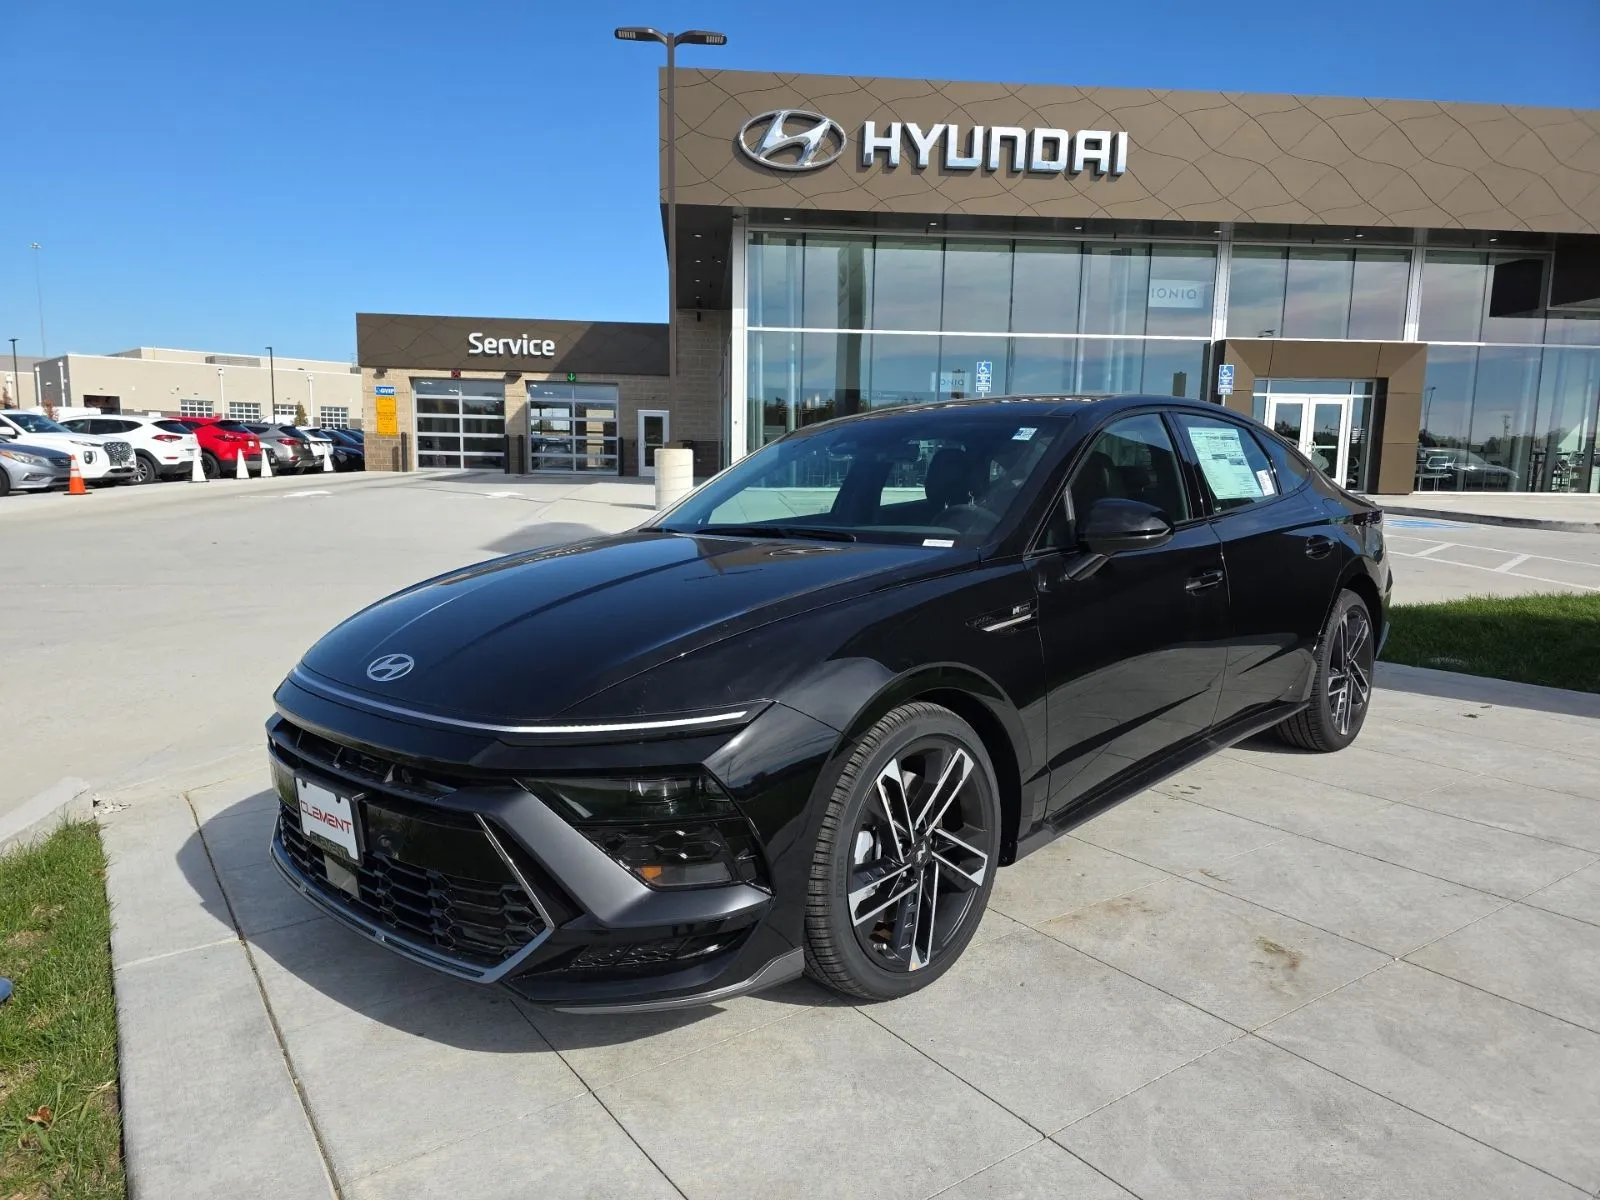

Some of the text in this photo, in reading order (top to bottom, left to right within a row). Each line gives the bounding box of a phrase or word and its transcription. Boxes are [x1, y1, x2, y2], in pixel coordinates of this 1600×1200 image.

[862, 121, 1128, 177] HYUNDAI
[468, 332, 556, 356] Service
[301, 800, 352, 835] CLEMENT
